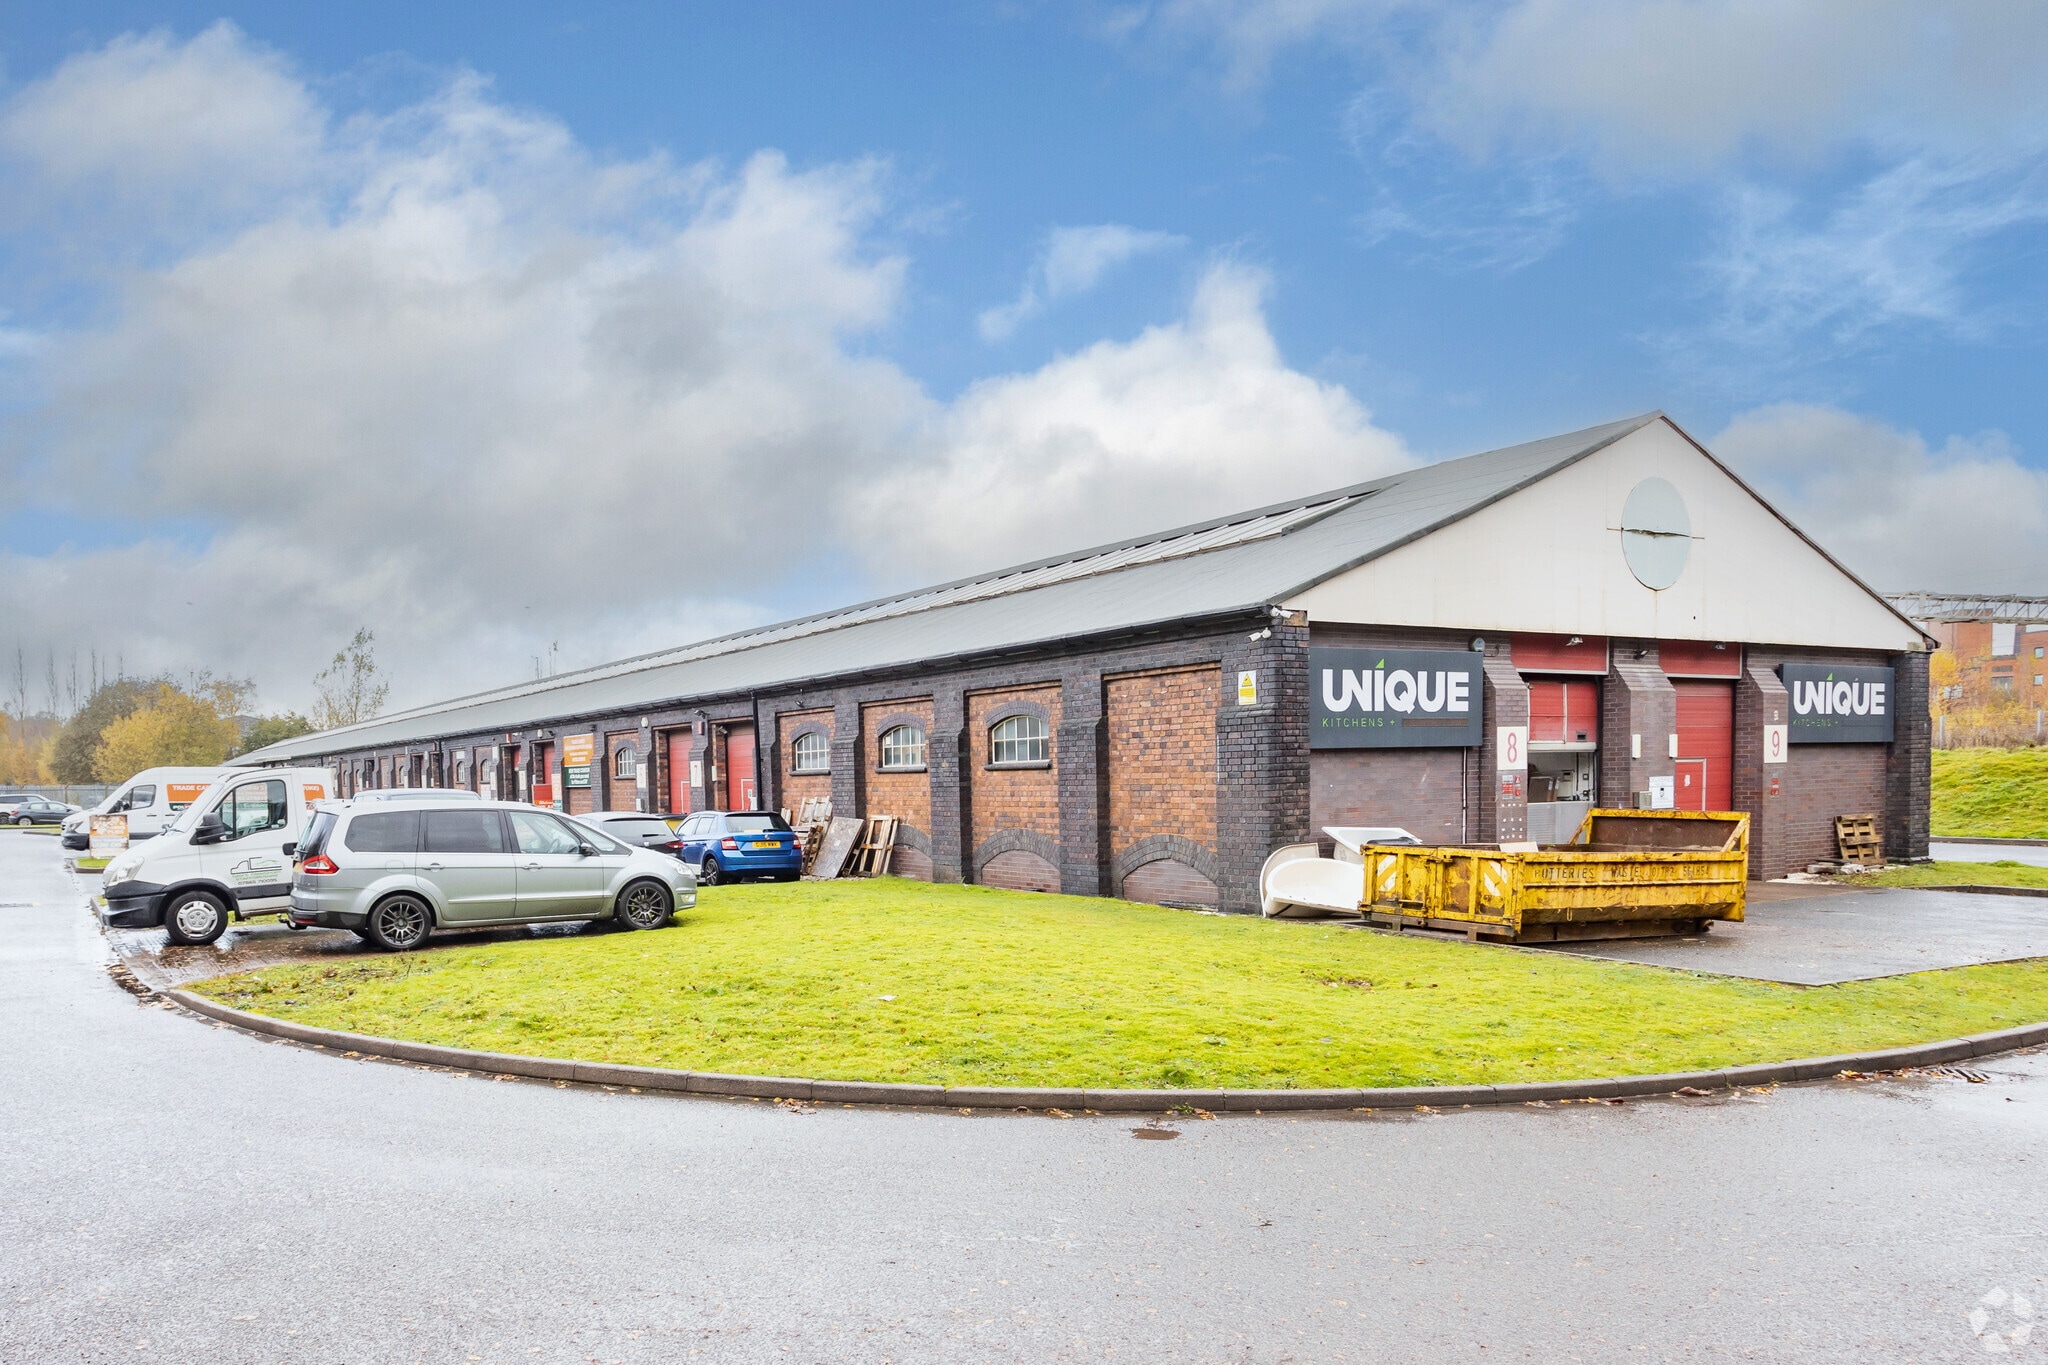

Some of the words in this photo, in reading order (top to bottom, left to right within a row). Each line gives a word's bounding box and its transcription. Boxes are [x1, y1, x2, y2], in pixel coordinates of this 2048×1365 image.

[1322, 718, 1384, 727] KITCHENS
[1507, 732, 1518, 763] 8
[1772, 730, 1780, 757] 9
[1534, 867, 1595, 879] POTTERIES
[1611, 866, 1640, 878] WASTE
